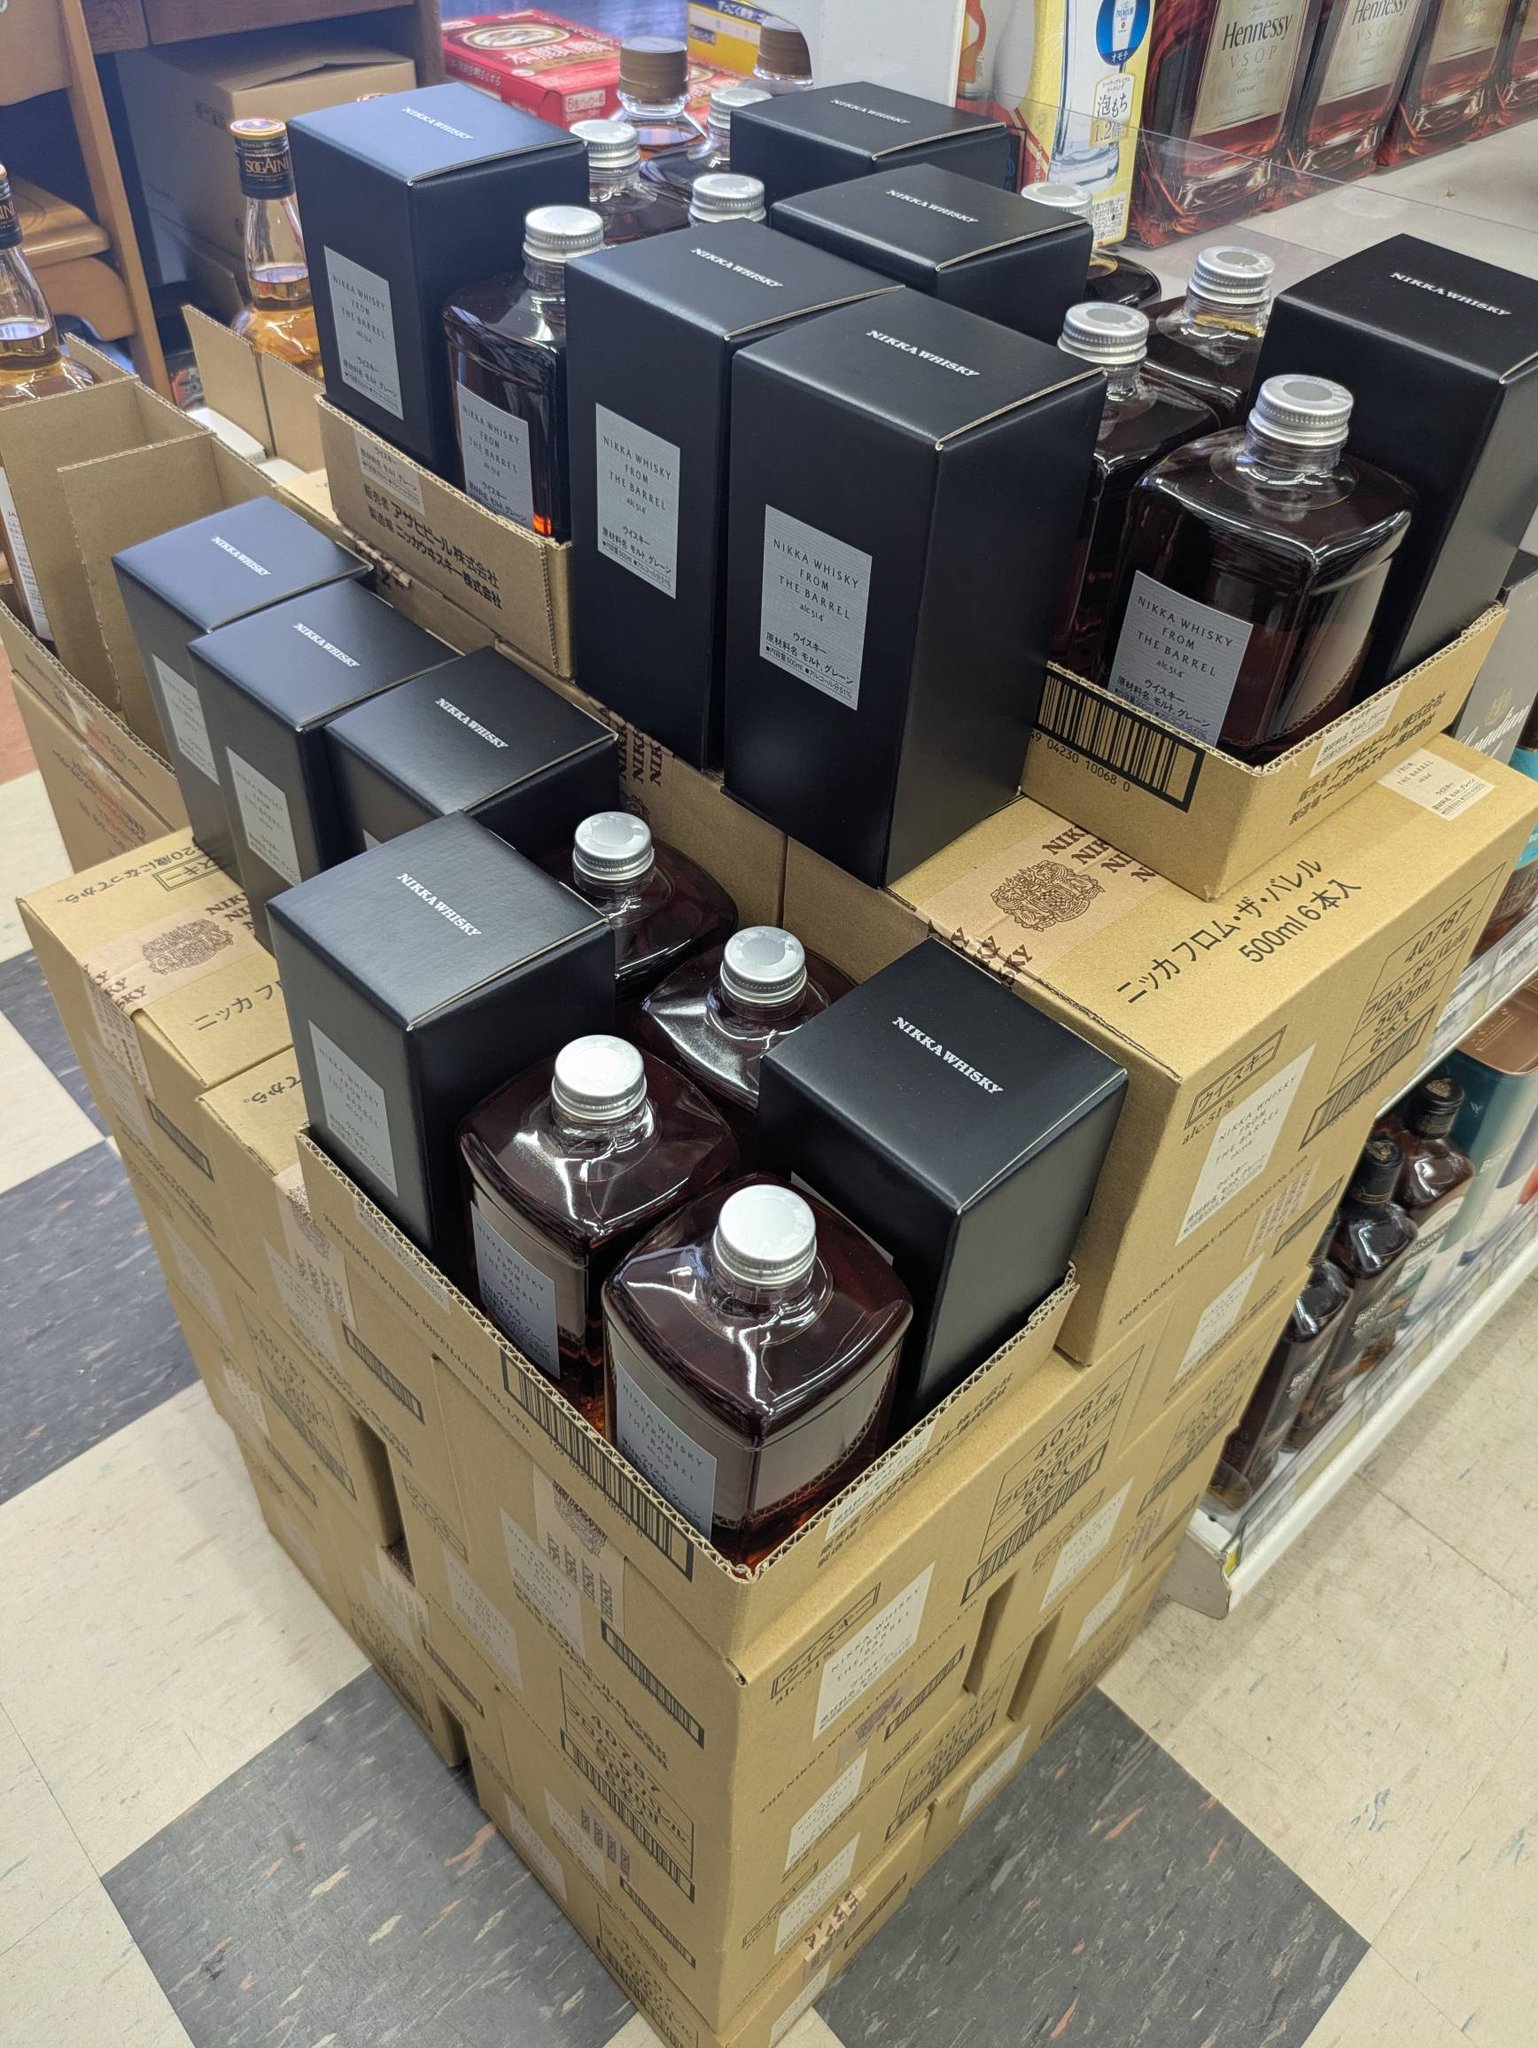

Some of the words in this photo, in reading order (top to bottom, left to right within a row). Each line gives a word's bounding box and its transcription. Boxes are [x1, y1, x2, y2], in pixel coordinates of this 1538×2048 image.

[1222, 14, 1293, 50] Hennessy
[1352, 0, 1408, 25] Hennessy
[830, 98, 869, 114] NIKKA
[865, 107, 911, 124] WHISKY
[1098, 93, 1127, 118] 泡もち
[886, 189, 930, 211] NIKKA
[927, 203, 979, 223] WHISKY
[690, 247, 733, 269] NIKKA
[730, 264, 784, 288] WHISKY
[333, 274, 356, 296] NIKKA
[358, 289, 385, 311] WHISKY
[352, 300, 370, 315] FROM
[1389, 271, 1447, 296] NIKKA
[1441, 289, 1512, 317] WHISKY
[342, 307, 354, 321] THE
[358, 317, 385, 339] BARREL
[865, 329, 918, 357] NIKKA
[914, 349, 981, 377] WHISKY
[463, 405, 484, 424] NIKKA
[488, 422, 519, 444] WHISKY
[481, 432, 499, 448] FROM
[469, 437, 482, 452] THE
[485, 448, 518, 473] BARREL
[603, 436, 632, 459] NIKKA
[635, 454, 671, 480] WHISKY
[624, 464, 648, 483] FROM
[609, 471, 626, 488] THE
[630, 483, 666, 511] BARREL
[211, 536, 240, 558] NIKKA
[237, 554, 271, 576] WHISKY
[391, 501, 500, 590] アサヒビール株式会社
[603, 527, 627, 550] 原材料名
[631, 544, 671, 574] モルト、グレーン
[623, 526, 650, 545] ウイスキー
[773, 537, 809, 564] NIKKA
[813, 558, 858, 590] WHISKY
[799, 567, 829, 592] FROM
[778, 574, 799, 594] THE
[804, 588, 850, 621] BARREL
[293, 622, 324, 647] NIKKA
[321, 642, 360, 667] WHISKY
[793, 630, 827, 658] ウイスキー
[1136, 595, 1176, 623] NIKKA
[1179, 615, 1233, 650] WHISKY
[1161, 626, 1195, 650] FROM
[766, 631, 797, 657] 原材料名
[801, 650, 853, 688] モルト、グレーン
[1136, 630, 1160, 650] THE
[1164, 644, 1217, 677] BARREL
[1116, 675, 1151, 701] 原材料名
[1152, 694, 1210, 731] モルト、グレーン
[1143, 678, 1185, 706] ウイスキー
[435, 697, 470, 725] NIKKA
[467, 720, 509, 749] WHISKY
[1047, 738, 1079, 764] 04230
[1085, 760, 1116, 785] 10068
[1122, 782, 1131, 792] 0
[397, 873, 436, 906] NIKKA
[433, 901, 482, 937] WHISKY
[1239, 915, 1307, 965] 500ml
[1300, 876, 1362, 923] 6本入
[1116, 955, 1182, 1005] ニッカ
[1176, 858, 1323, 963] フロム・ザ・バレル
[1401, 895, 1473, 968] 40787
[1359, 921, 1472, 1026] フロム・ザ・バレル
[193, 996, 253, 1031] ニッカ
[1371, 967, 1437, 1035] 500ml
[1367, 1003, 1415, 1055] 6本入
[892, 1016, 942, 1057] NIKKA
[942, 1050, 1004, 1094] WHISKY
[1198, 1046, 1275, 1110] ウイスキー
[1217, 1107, 1254, 1144] NIKKA
[1255, 1072, 1297, 1113] WHISKY
[1237, 1106, 1267, 1137] FROM
[1214, 1141, 1236, 1165] THE
[1237, 1105, 1280, 1147] BARREL
[344, 1235, 377, 1275] NIKKA
[379, 1270, 418, 1318] WHISKY
[477, 1222, 503, 1259] NIKKA
[506, 1252, 544, 1297] WHISKY
[497, 1255, 521, 1285] FROM
[484, 1252, 502, 1278] THE
[504, 1272, 541, 1315] BARREL
[622, 1383, 654, 1426] NIKKA
[658, 1419, 702, 1472] WHISKY
[644, 1419, 673, 1454] FROM
[1031, 1380, 1111, 1466] 40787
[627, 1411, 649, 1440] THE
[652, 1436, 695, 1487] BARREL
[1019, 1429, 1091, 1508] 500ml
[569, 1459, 598, 1491] 04230
[603, 1494, 631, 1527] 10068
[781, 1599, 872, 1683] ウイスキー
[589, 1706, 661, 1801] 40787
